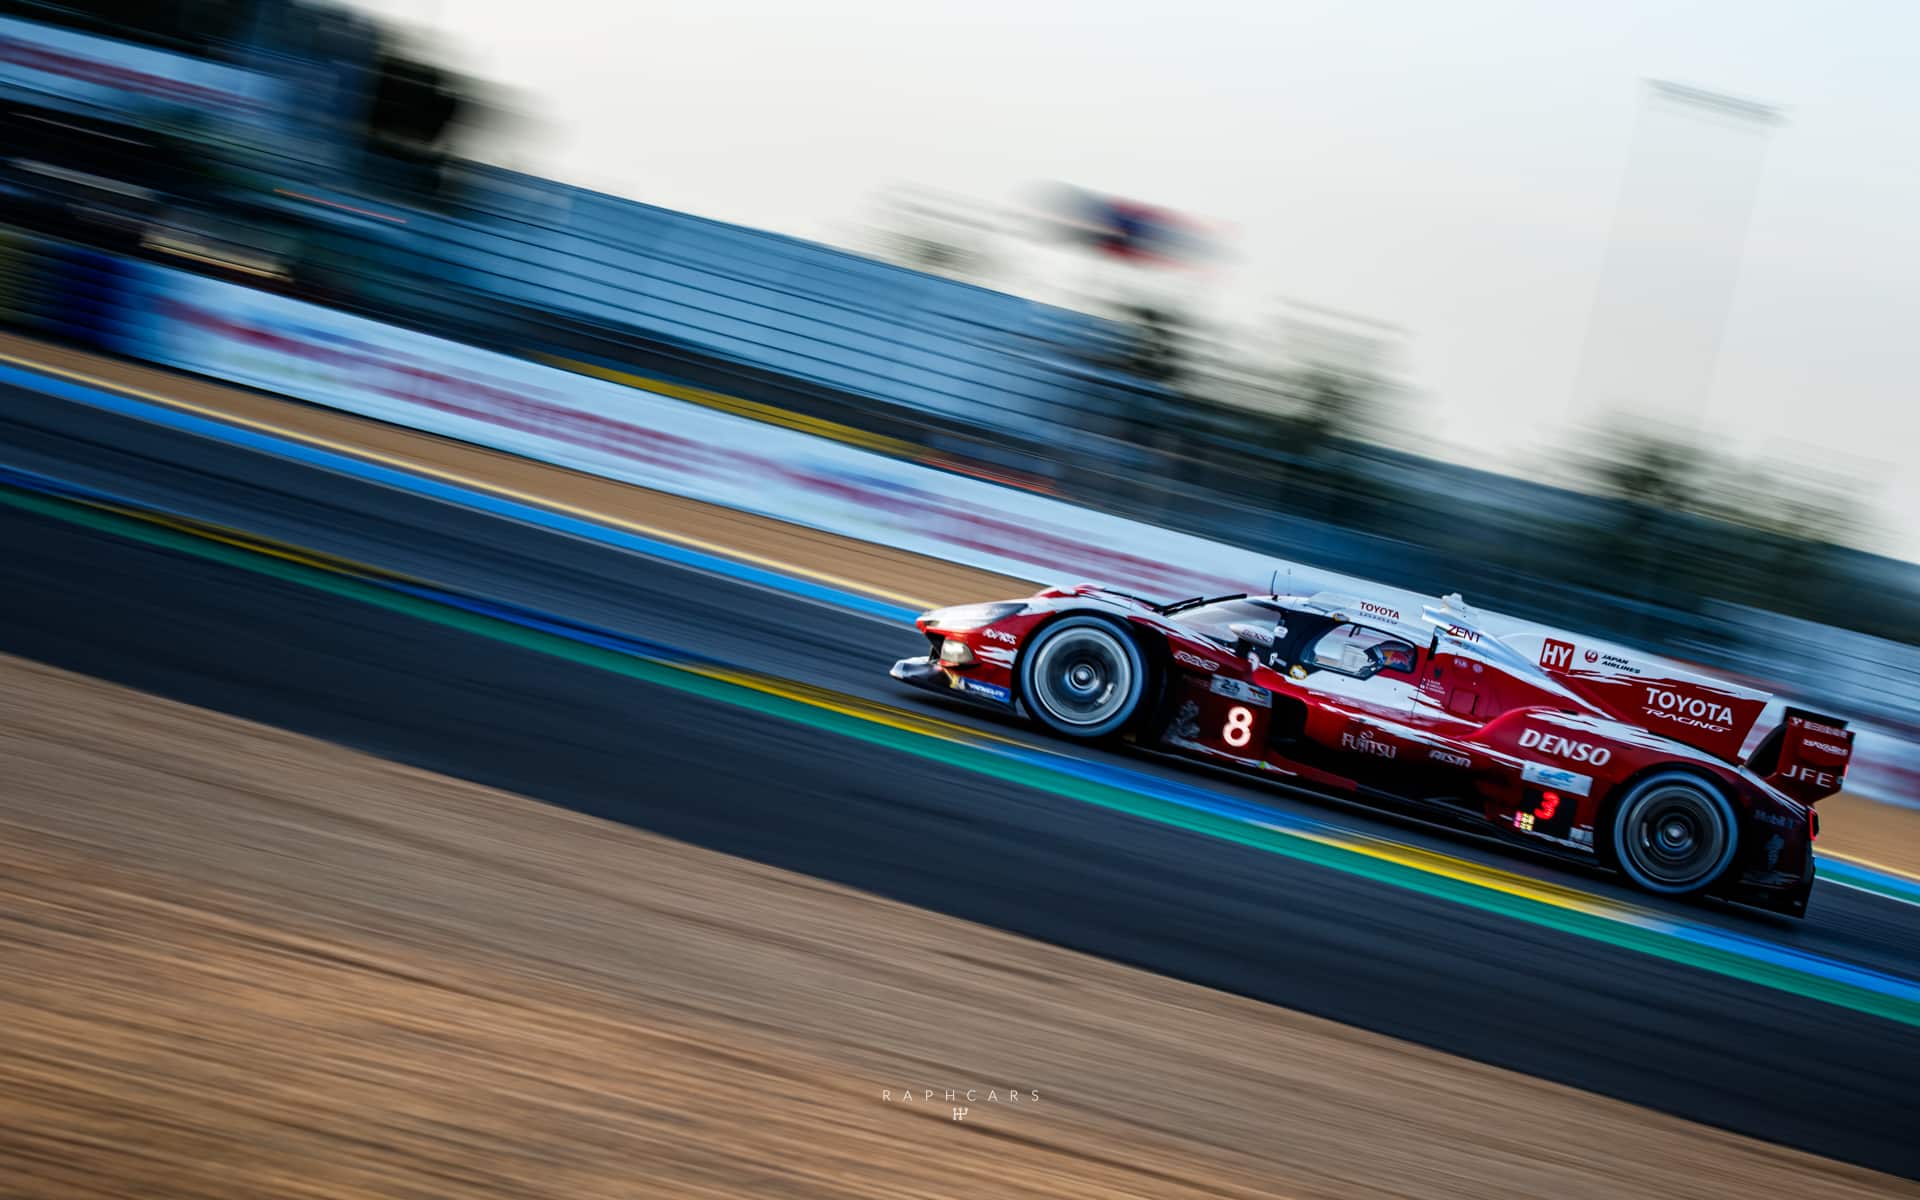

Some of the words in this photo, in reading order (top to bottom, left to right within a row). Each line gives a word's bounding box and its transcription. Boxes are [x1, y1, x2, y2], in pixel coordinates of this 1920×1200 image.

[1360, 601, 1399, 620] TOYOTA
[1446, 624, 1482, 643] ZENT
[1541, 643, 1573, 668] HY
[1601, 654, 1630, 665] JAPAN
[1601, 661, 1641, 674] AIRLINES
[1645, 687, 1734, 725] TOYOTA
[1222, 706, 1253, 748] 8
[1642, 707, 1732, 733] RACING
[1341, 731, 1398, 759] FUJITSU
[1518, 728, 1612, 767] DENSO
[1781, 764, 1834, 789] JFE
[1533, 791, 1560, 820] 3
